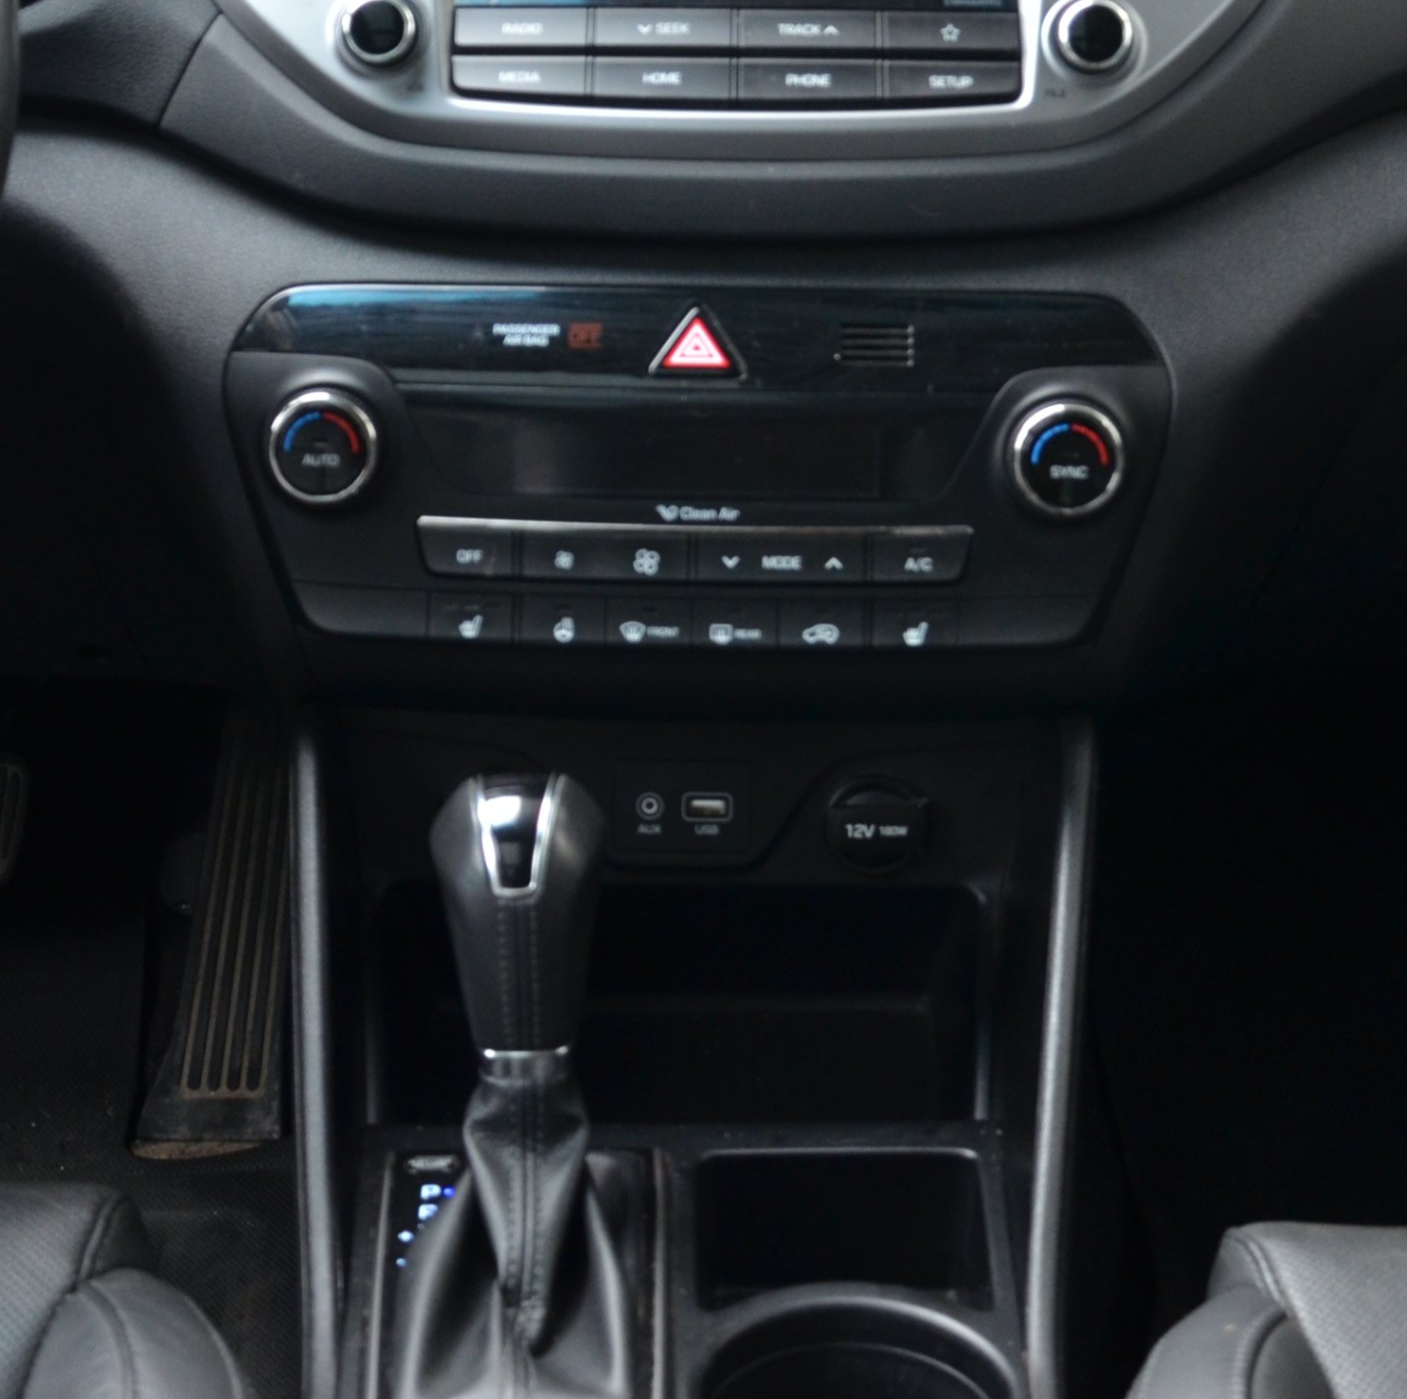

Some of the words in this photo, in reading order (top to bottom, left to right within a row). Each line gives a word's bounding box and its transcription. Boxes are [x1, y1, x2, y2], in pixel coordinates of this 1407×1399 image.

[501, 22, 543, 34] RADIO
[655, 21, 690, 35] SEEK
[777, 22, 821, 37] TRACK
[498, 71, 541, 83] MEDIA
[643, 71, 682, 85] HOME
[785, 72, 833, 88] PHONE
[928, 74, 974, 89] SETUP
[492, 323, 561, 336] PASSENGER
[302, 453, 340, 467] AUTO
[1050, 465, 1089, 479] SYNC
[679, 506, 716, 521] Clean
[718, 507, 740, 521] Air
[761, 555, 803, 570] MODE
[904, 556, 934, 572] A/C
[637, 824, 662, 835] AUX
[695, 824, 720, 836] USB
[845, 823, 875, 838] 12V
